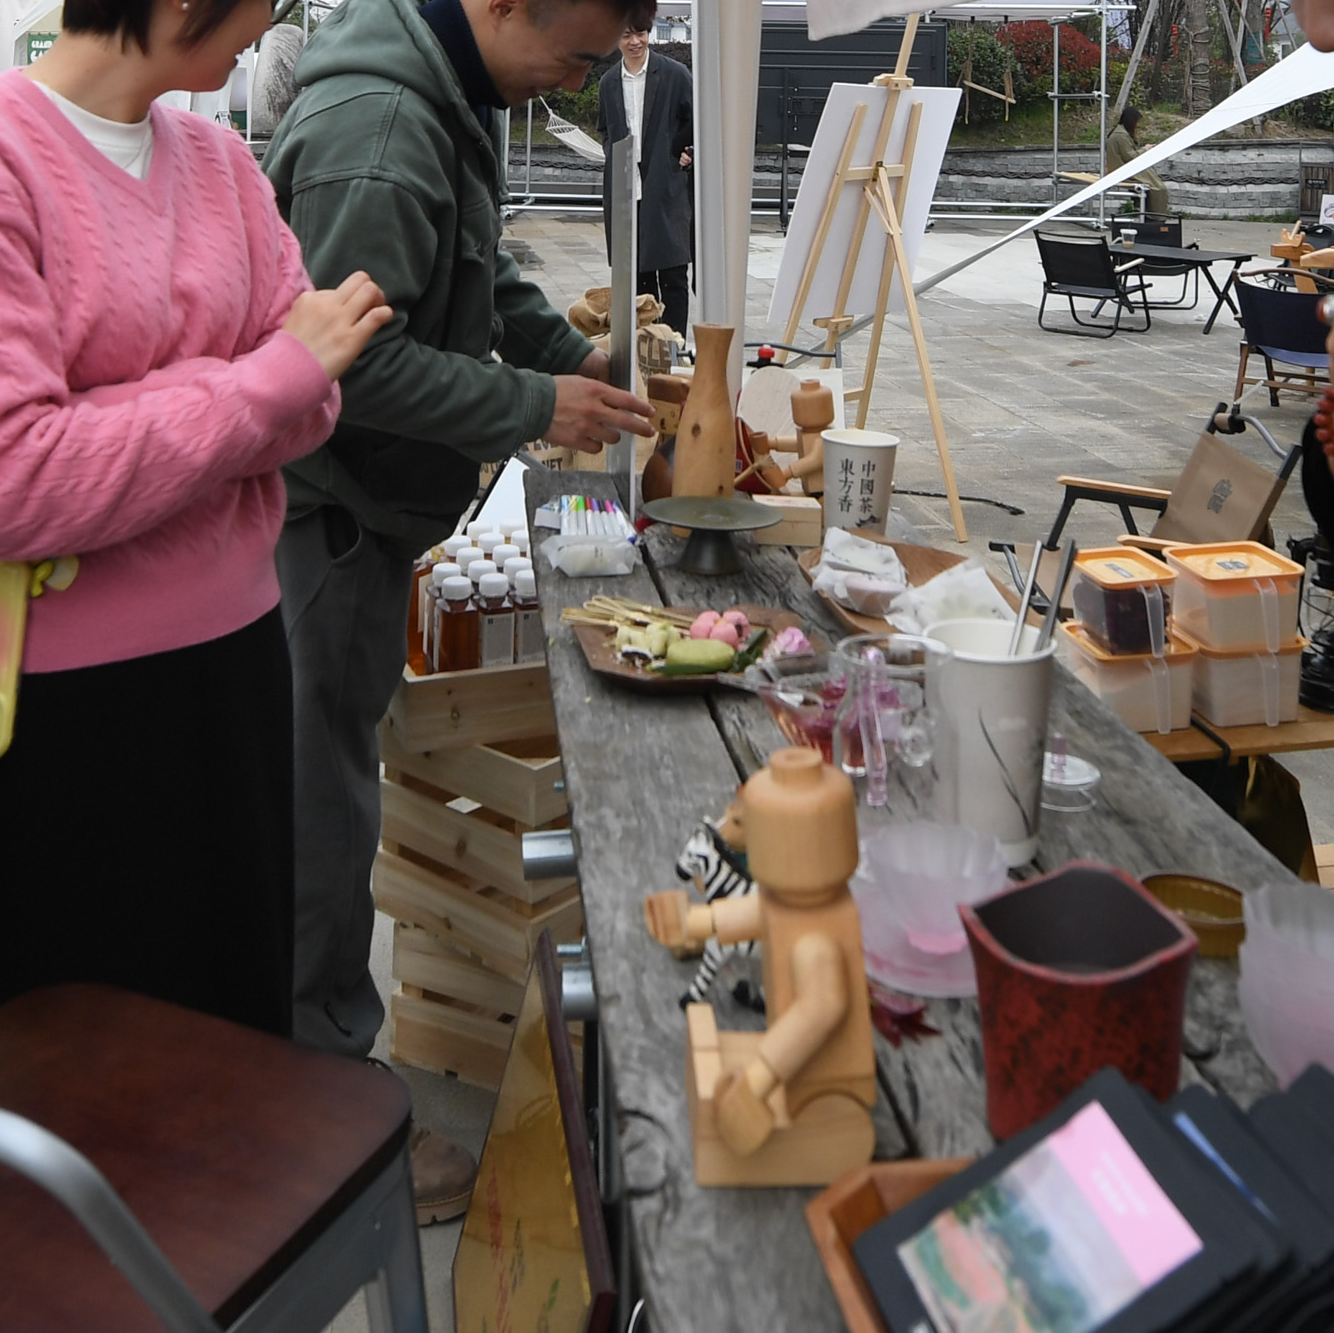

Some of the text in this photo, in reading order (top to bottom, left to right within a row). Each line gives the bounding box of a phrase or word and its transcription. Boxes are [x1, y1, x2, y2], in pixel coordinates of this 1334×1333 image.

[837, 457, 855, 514] 東方香
[859, 459, 877, 515] 中國茶
